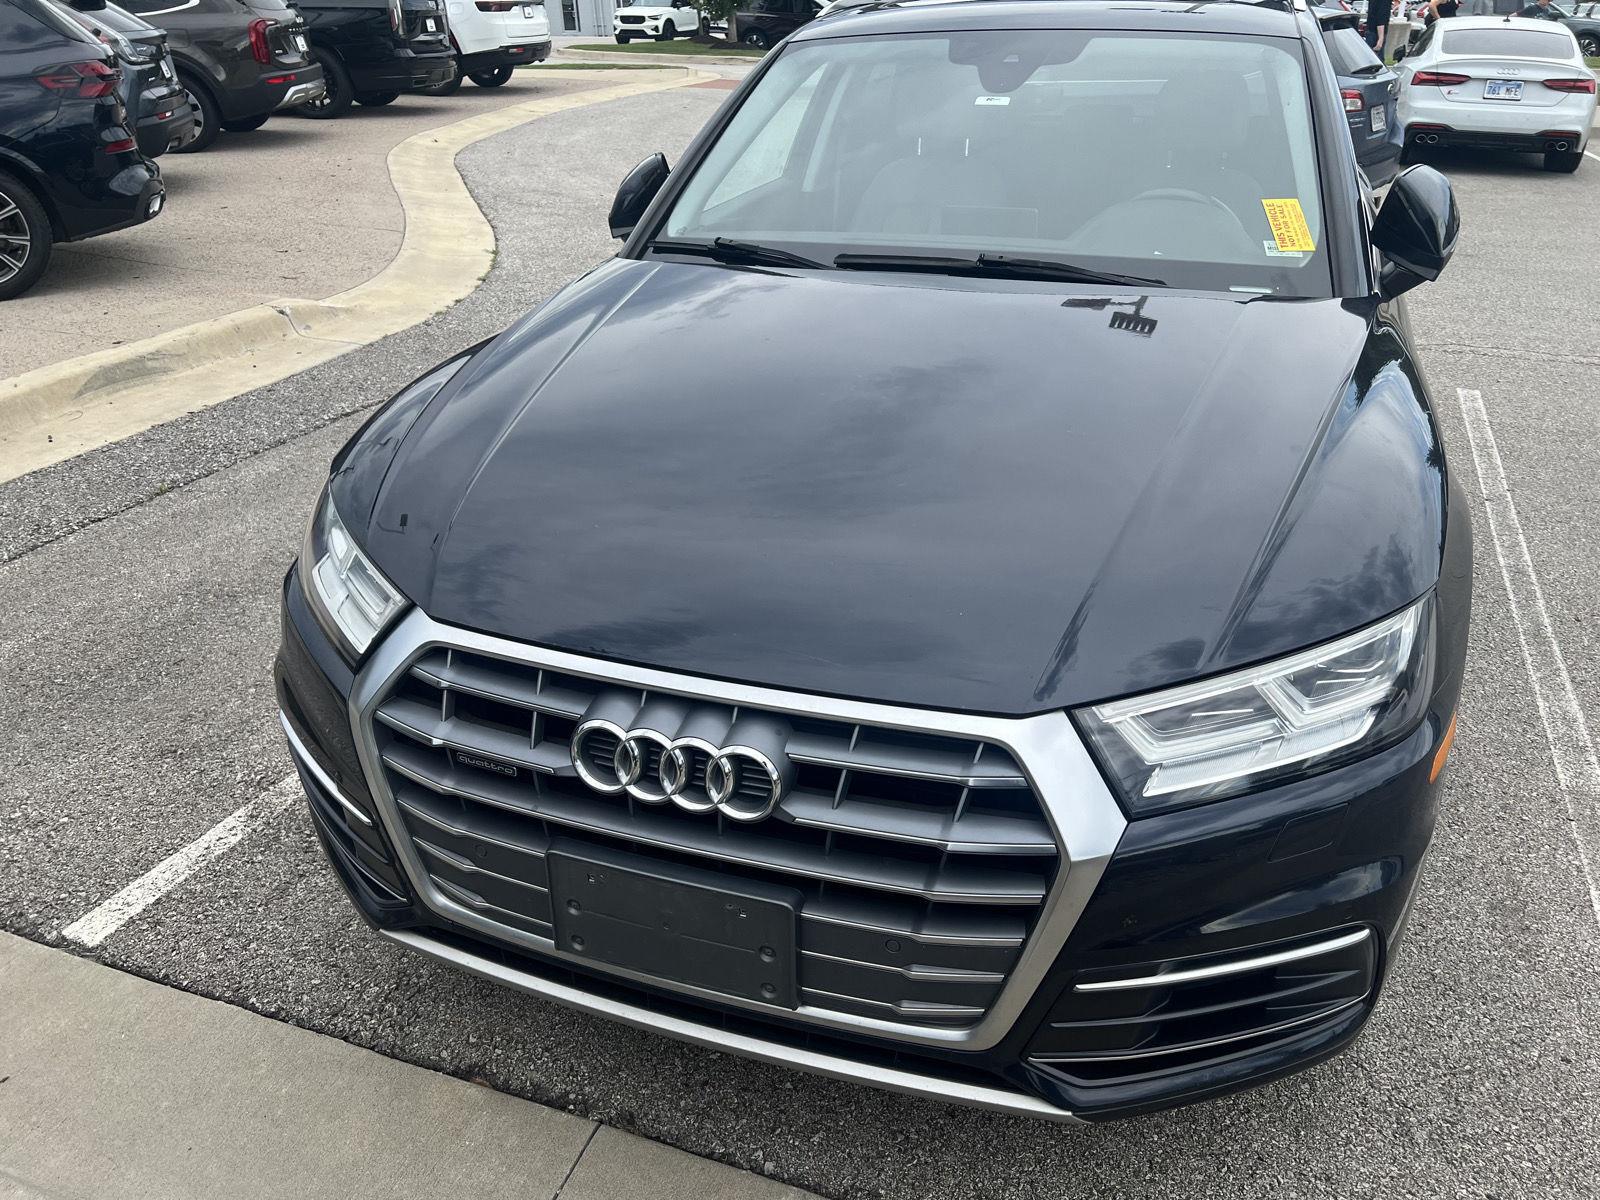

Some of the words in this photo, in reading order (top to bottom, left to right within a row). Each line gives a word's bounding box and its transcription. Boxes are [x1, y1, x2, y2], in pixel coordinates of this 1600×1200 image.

[1266, 203, 1282, 231] VEHICLE
[1276, 204, 1287, 219] SALE
[1282, 220, 1291, 232] FOR
[1277, 232, 1289, 248] THIS
[1287, 235, 1296, 247] NOT
[459, 756, 513, 774] quattro
